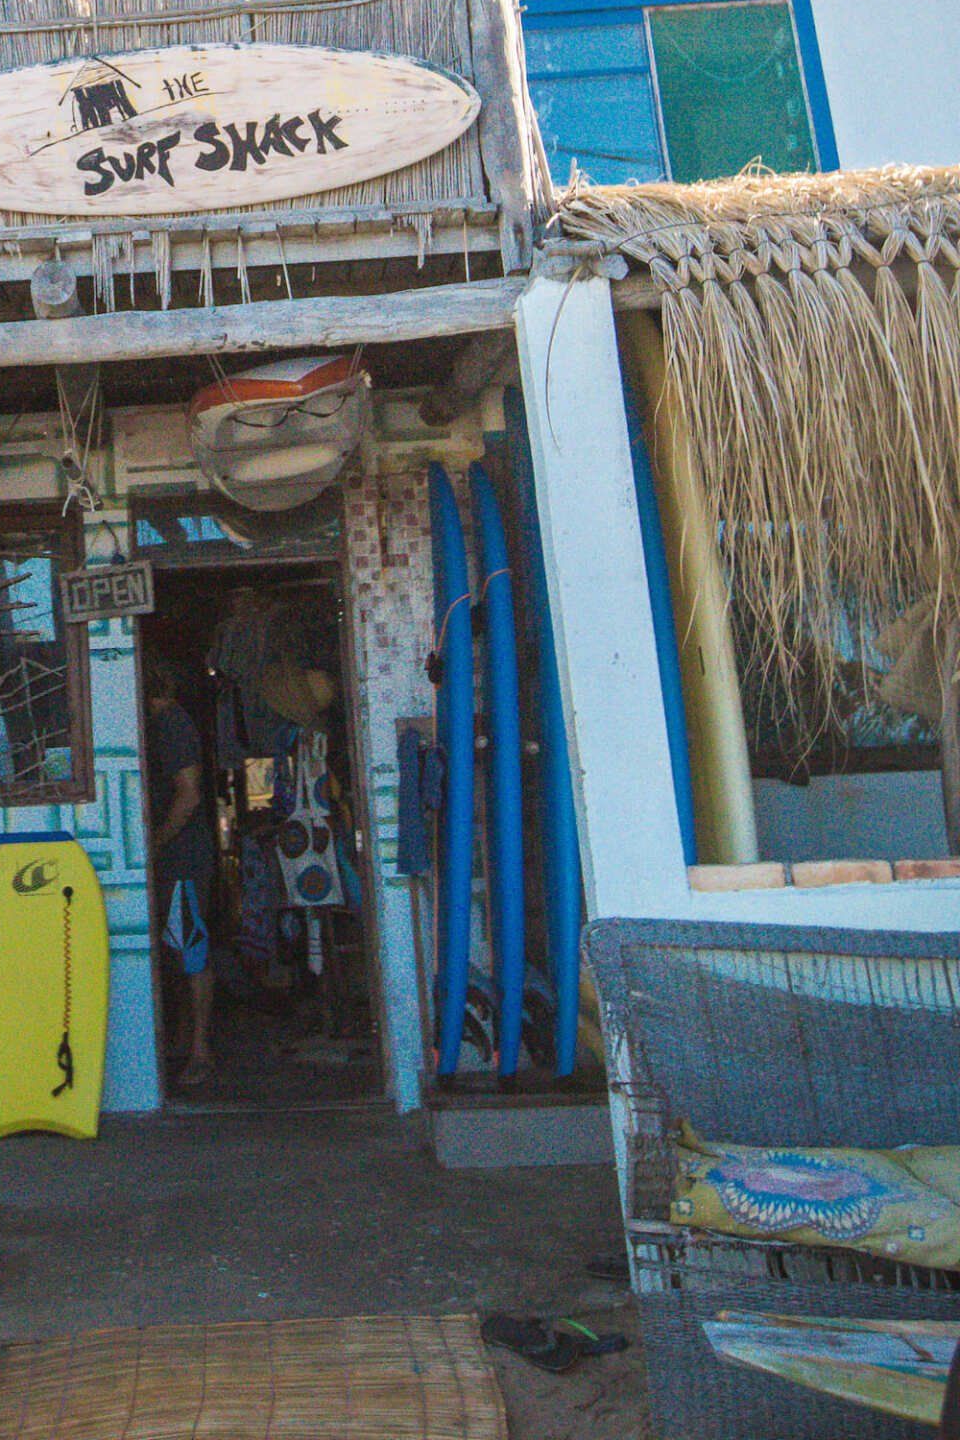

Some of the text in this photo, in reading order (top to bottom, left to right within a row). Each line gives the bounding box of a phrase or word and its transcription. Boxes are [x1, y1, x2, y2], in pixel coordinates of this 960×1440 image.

[76, 108, 350, 196] SURF SHACK
[70, 571, 146, 611] OPEN
